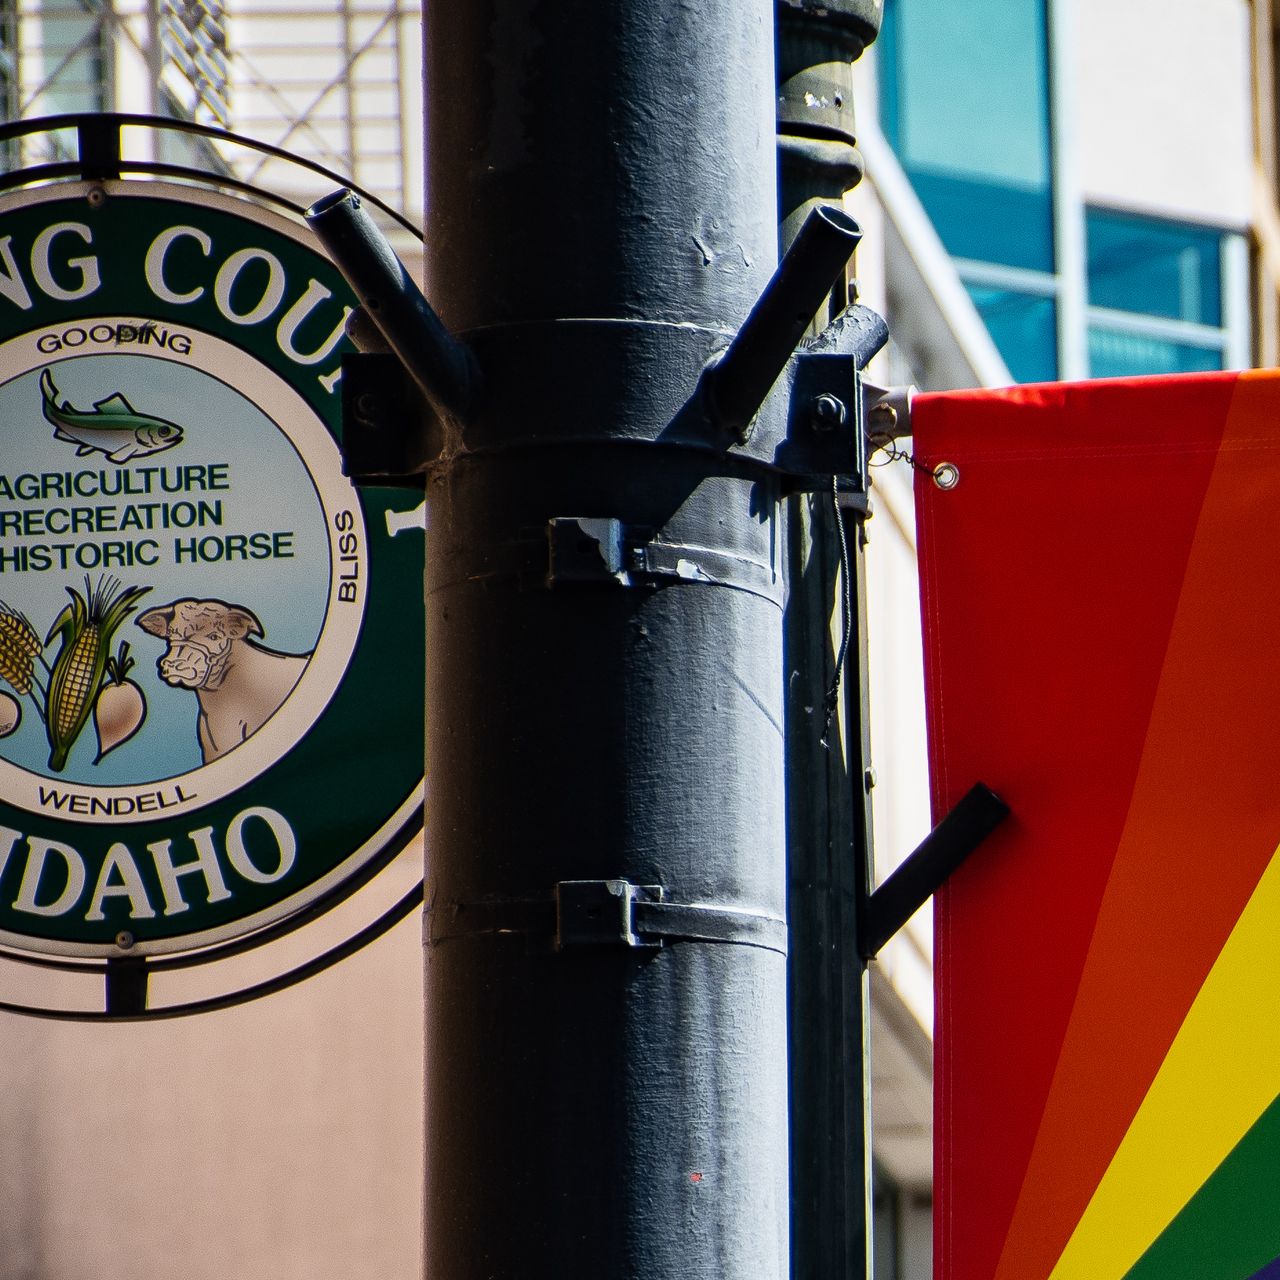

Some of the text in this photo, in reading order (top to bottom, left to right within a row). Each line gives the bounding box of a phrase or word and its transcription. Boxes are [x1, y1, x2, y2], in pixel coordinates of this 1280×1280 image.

[36, 324, 192, 355] GOODING
[0, 464, 230, 500] AGRICULTURE
[0, 500, 222, 537] RECREATION
[0, 532, 294, 573] HISTORIC HORSE
[335, 509, 359, 603] BLISS
[39, 785, 197, 816] WENDELL
